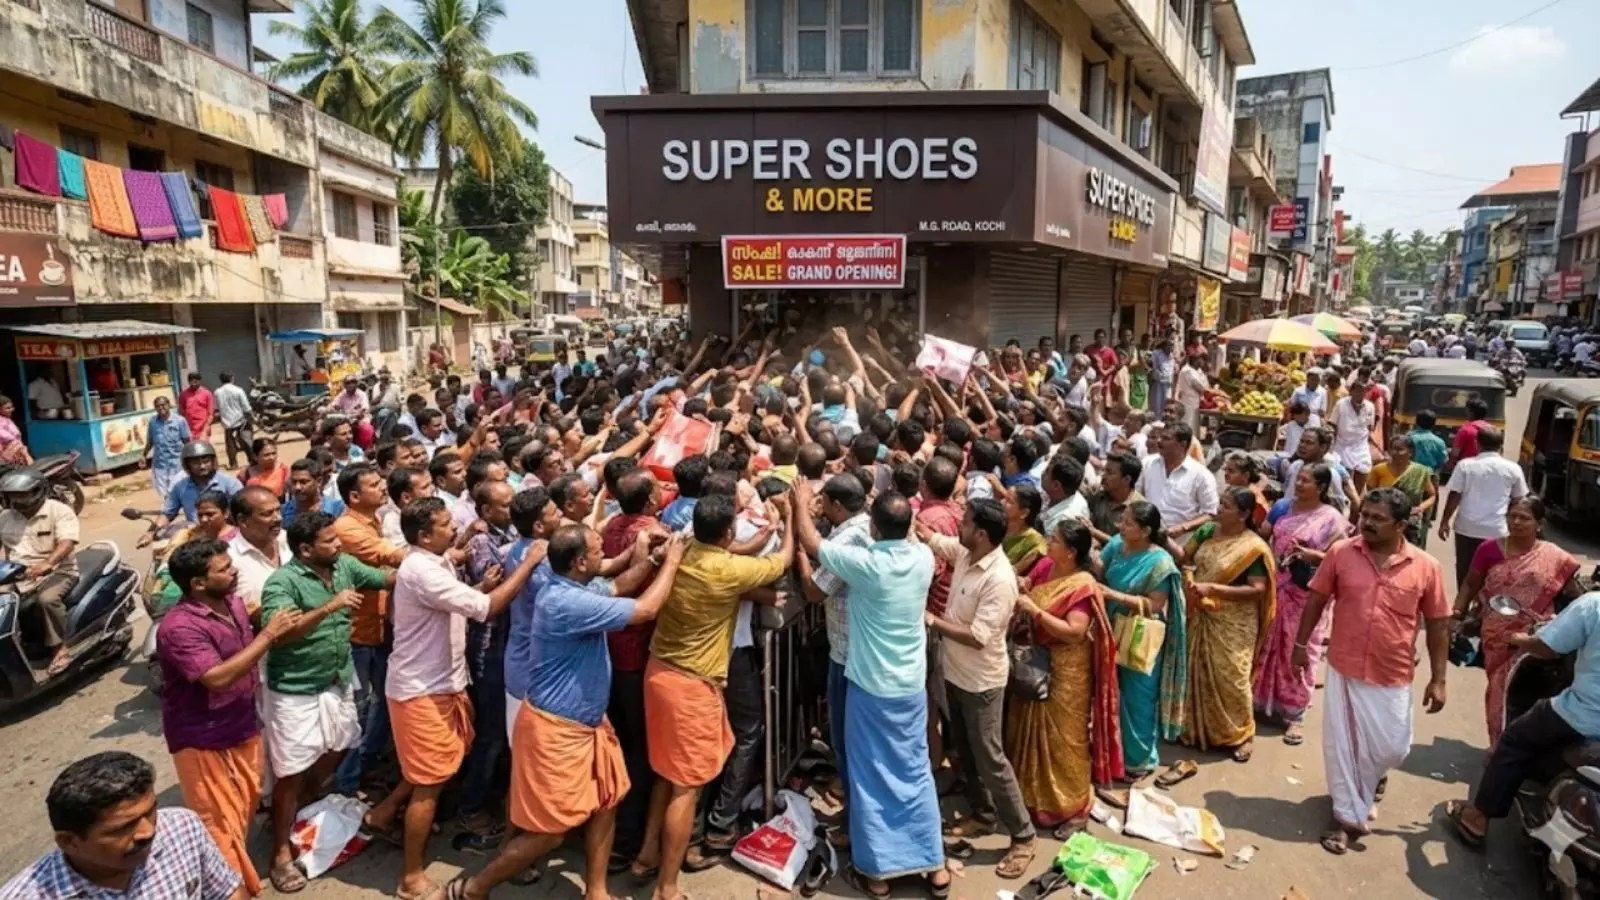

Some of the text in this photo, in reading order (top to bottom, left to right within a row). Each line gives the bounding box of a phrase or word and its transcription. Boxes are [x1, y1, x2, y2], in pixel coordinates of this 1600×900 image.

[662, 137, 979, 181] SUPER SHOES
[766, 187, 873, 213] & MORE
[1089, 166, 1127, 213] SUPER
[919, 220, 1006, 232] M.G. ROAD, KOCHI
[732, 264, 897, 281] SALE! GRAND OPENING!
[20, 343, 53, 356] TEA
